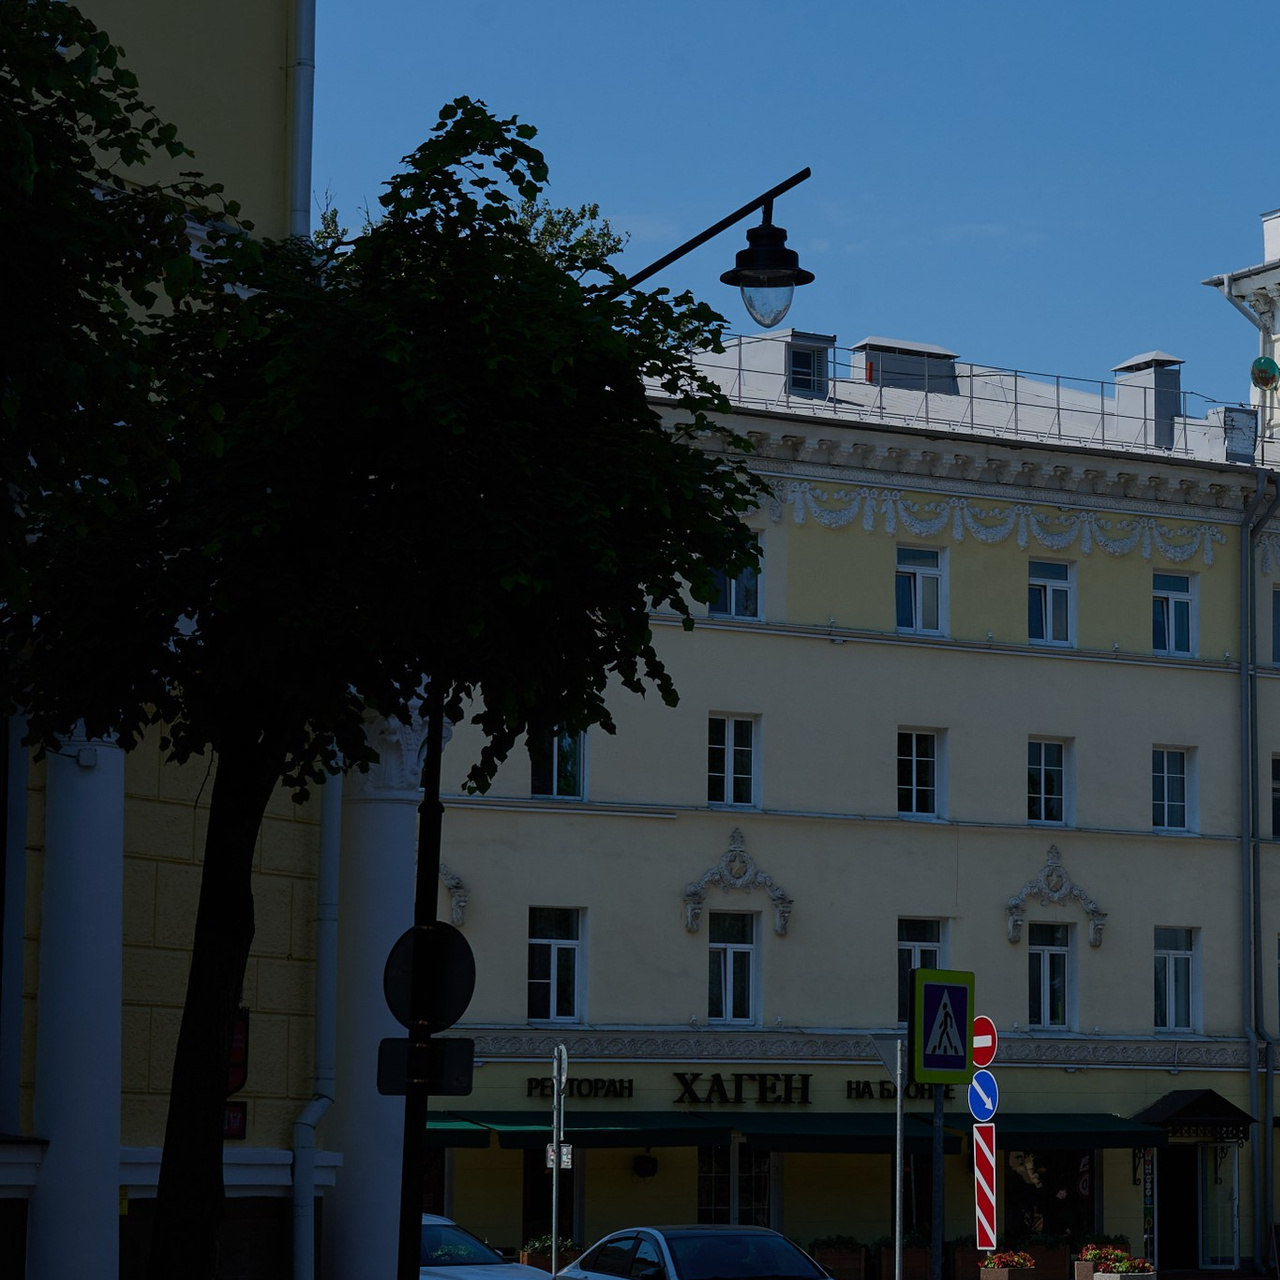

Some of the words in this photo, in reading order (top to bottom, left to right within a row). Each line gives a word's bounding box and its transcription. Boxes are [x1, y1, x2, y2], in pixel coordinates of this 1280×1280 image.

[527, 1077, 634, 1098] РЕТОРАН
[673, 1072, 813, 1104] ХАГЕН
[846, 1080, 875, 1099] НА
